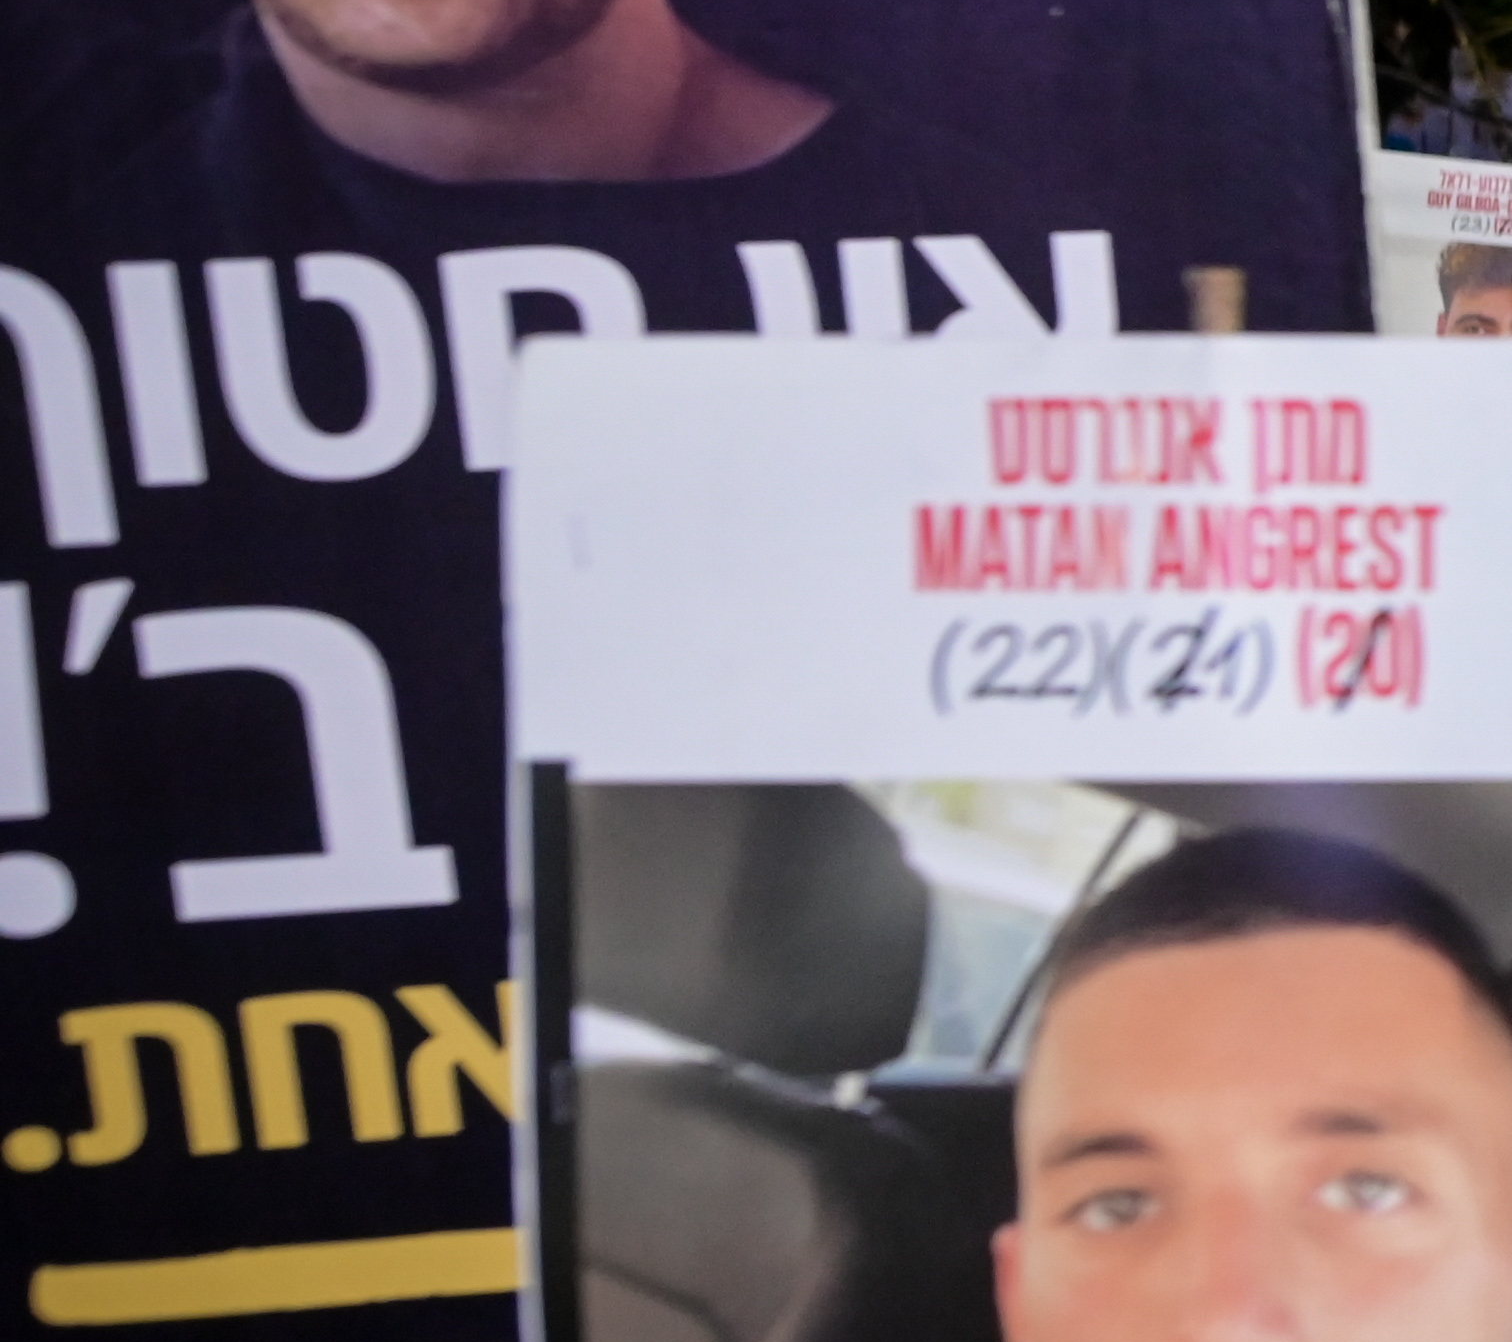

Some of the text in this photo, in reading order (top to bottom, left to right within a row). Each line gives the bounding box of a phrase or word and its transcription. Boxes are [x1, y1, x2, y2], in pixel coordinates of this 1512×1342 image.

[1428, 189, 1453, 209] GUY
[908, 502, 1443, 595] MATAN ANGREST
